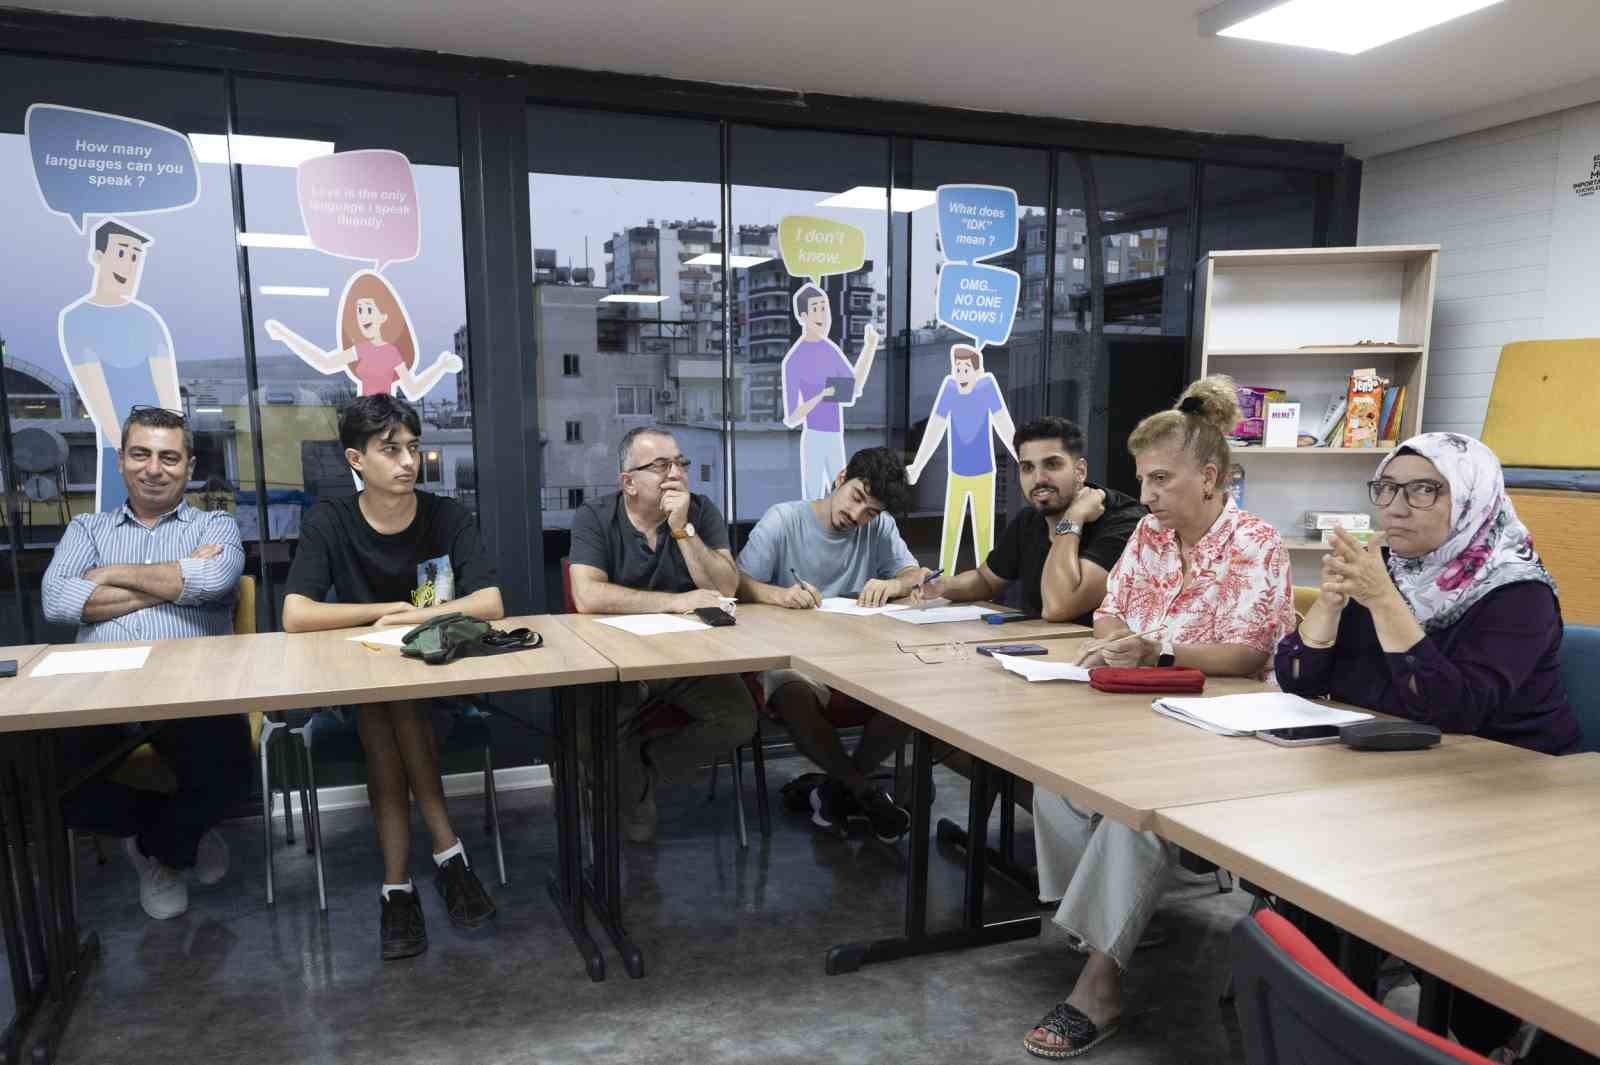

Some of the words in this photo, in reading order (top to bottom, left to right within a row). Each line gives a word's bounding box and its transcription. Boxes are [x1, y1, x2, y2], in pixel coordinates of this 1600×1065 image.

[75, 139, 108, 153] How
[112, 144, 152, 158] many
[45, 154, 122, 171] languages
[127, 160, 153, 172] can
[156, 163, 184, 176] you
[88, 173, 133, 187] speak
[136, 175, 145, 188] ?
[345, 188, 356, 199] is
[359, 188, 378, 200] the
[380, 190, 408, 202] only
[308, 200, 366, 214] language
[375, 203, 410, 216] speak
[949, 201, 976, 215] What
[979, 204, 1006, 218] does
[795, 225, 802, 240] I
[955, 234, 985, 245] mean
[989, 234, 996, 246] ?
[954, 293, 973, 306] NO
[976, 295, 1003, 308] ONE
[951, 308, 997, 323] KNOWS
